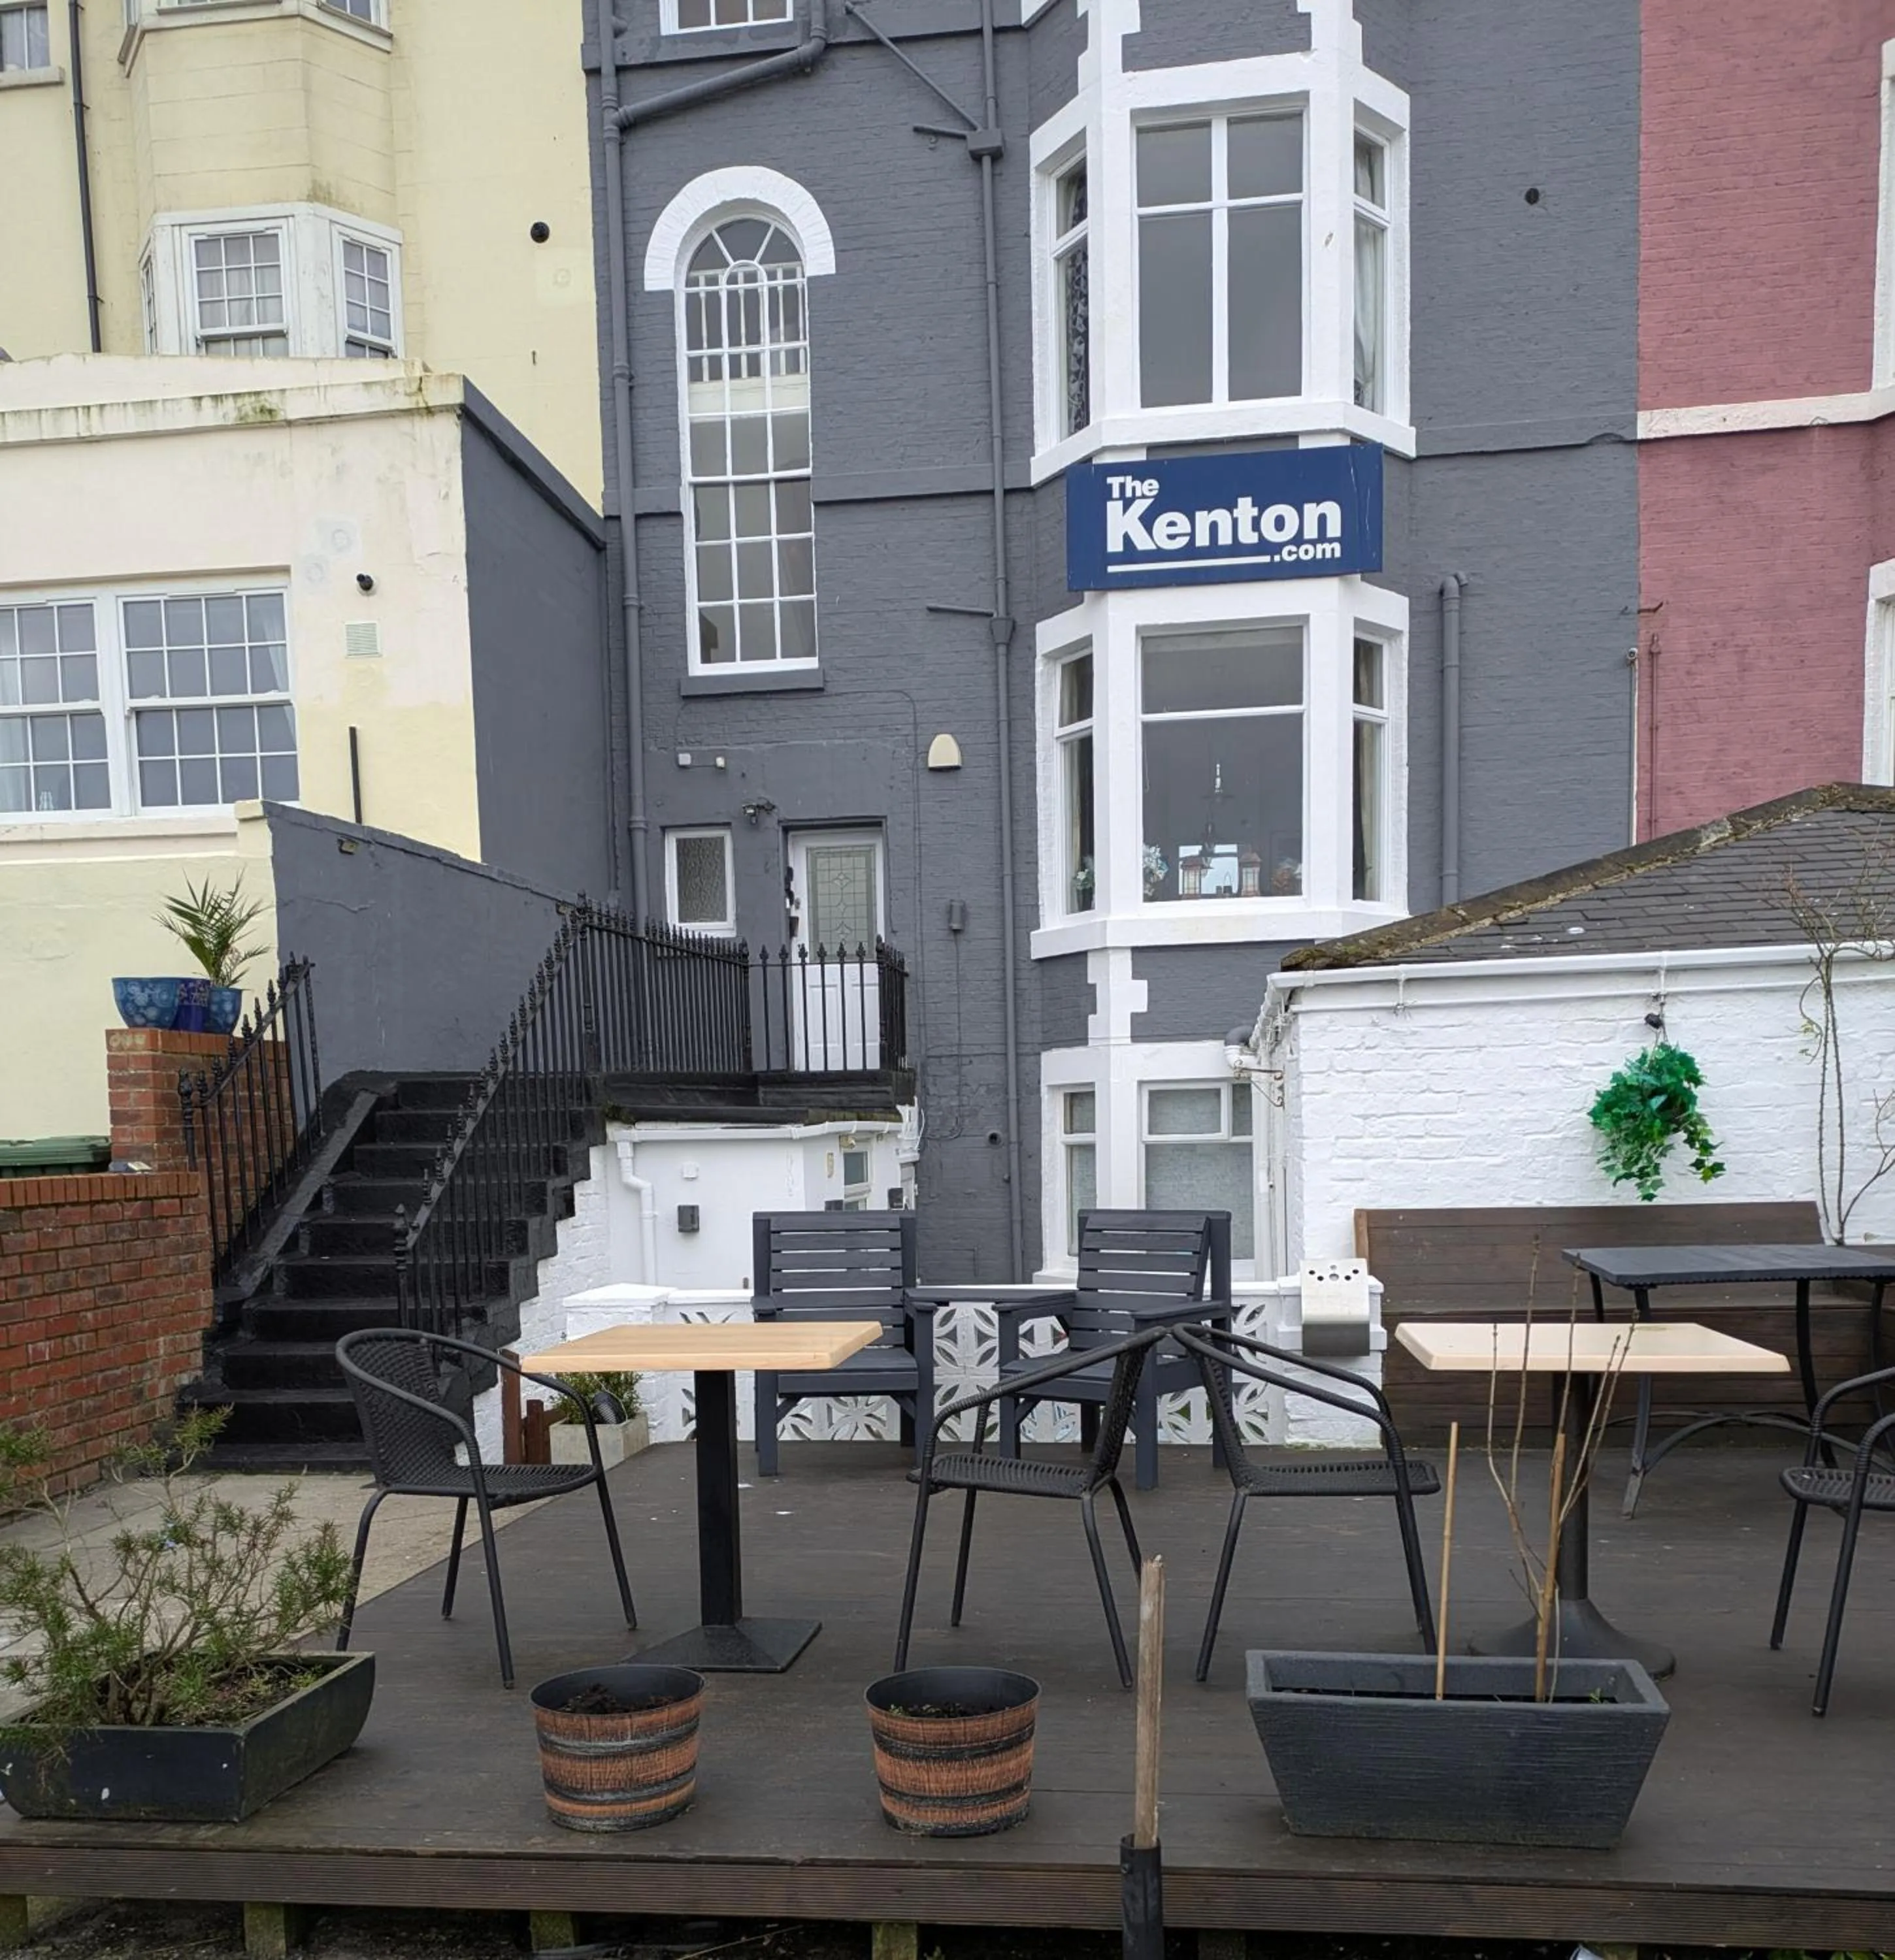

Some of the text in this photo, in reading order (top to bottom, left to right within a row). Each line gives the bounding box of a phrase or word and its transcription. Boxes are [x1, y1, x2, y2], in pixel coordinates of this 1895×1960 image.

[1106, 475, 1159, 498] The
[1106, 497, 1342, 553] Kenton
[1274, 542, 1341, 563] .com
